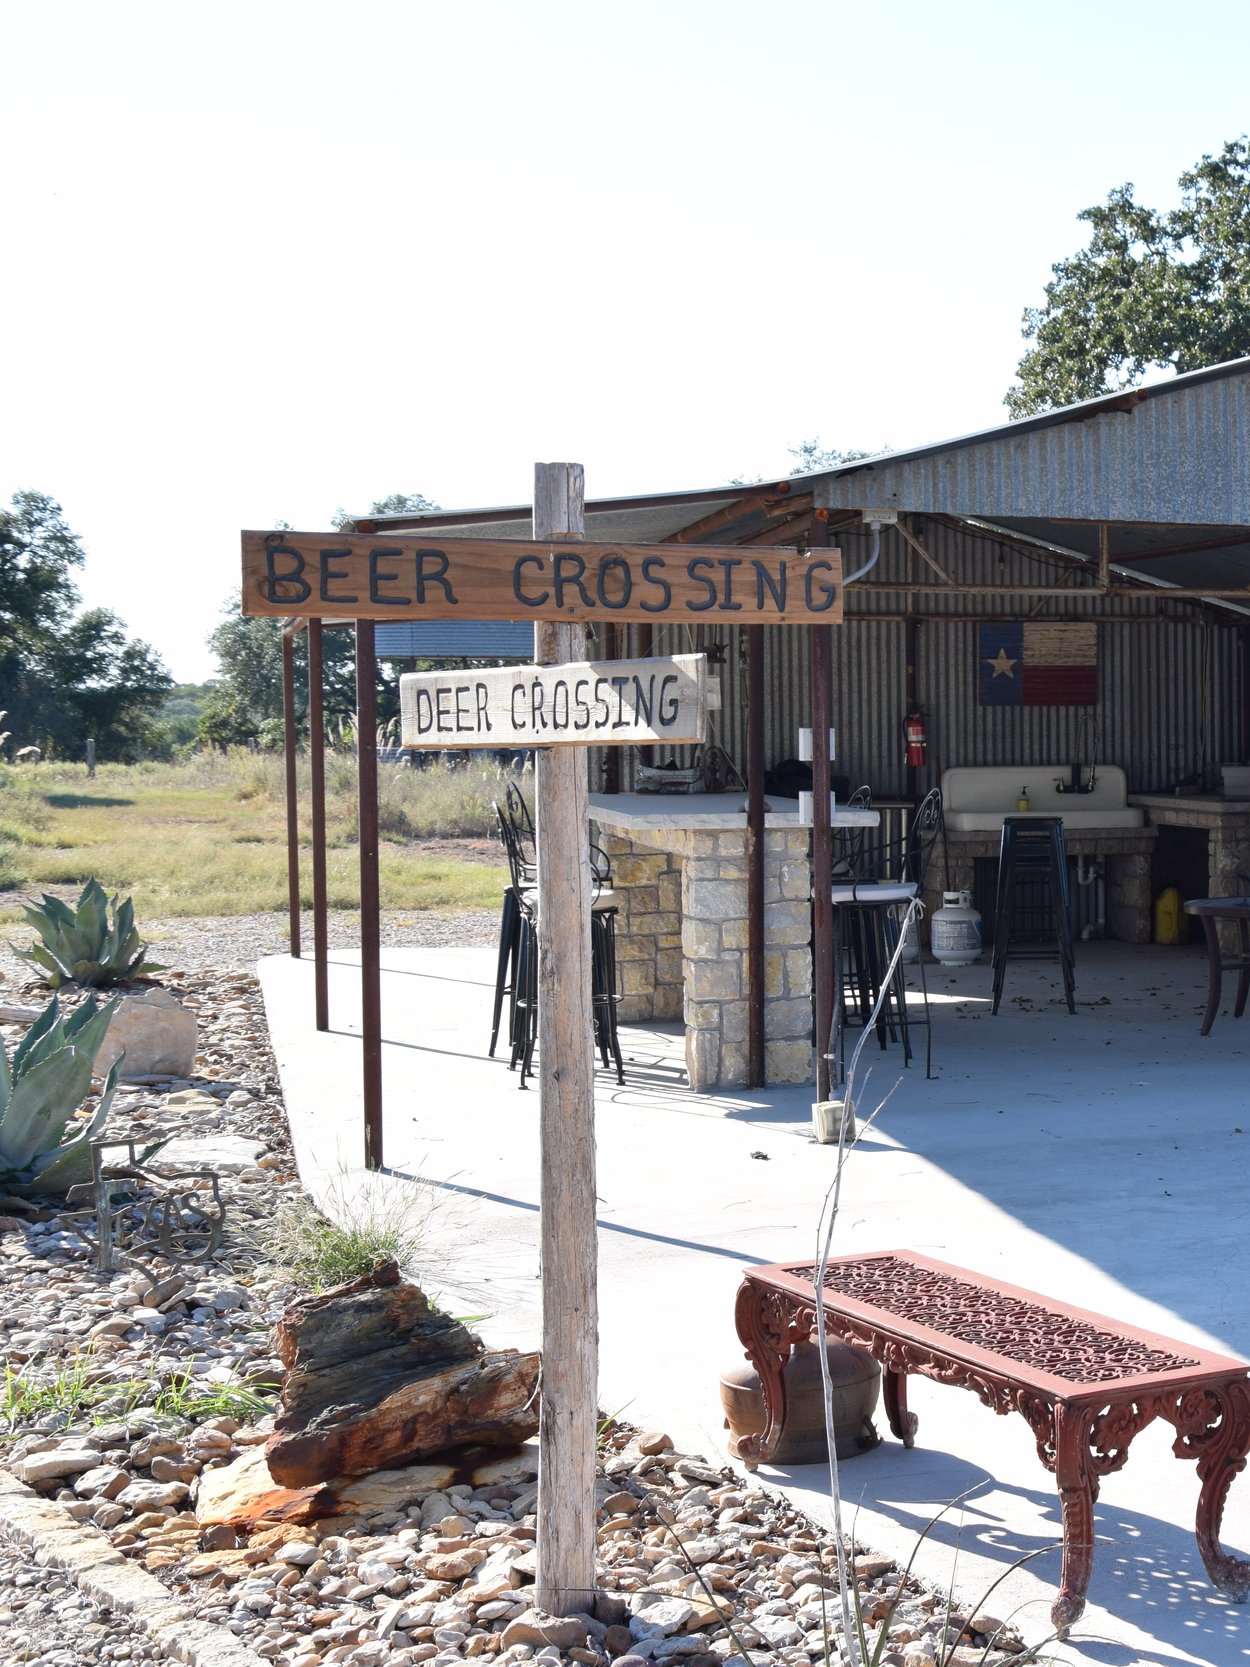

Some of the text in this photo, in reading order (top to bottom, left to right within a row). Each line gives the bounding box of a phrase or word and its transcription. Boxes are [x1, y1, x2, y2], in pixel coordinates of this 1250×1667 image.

[266, 545, 837, 613] BEER CROSSING
[417, 674, 679, 735] DEER CROSSING
